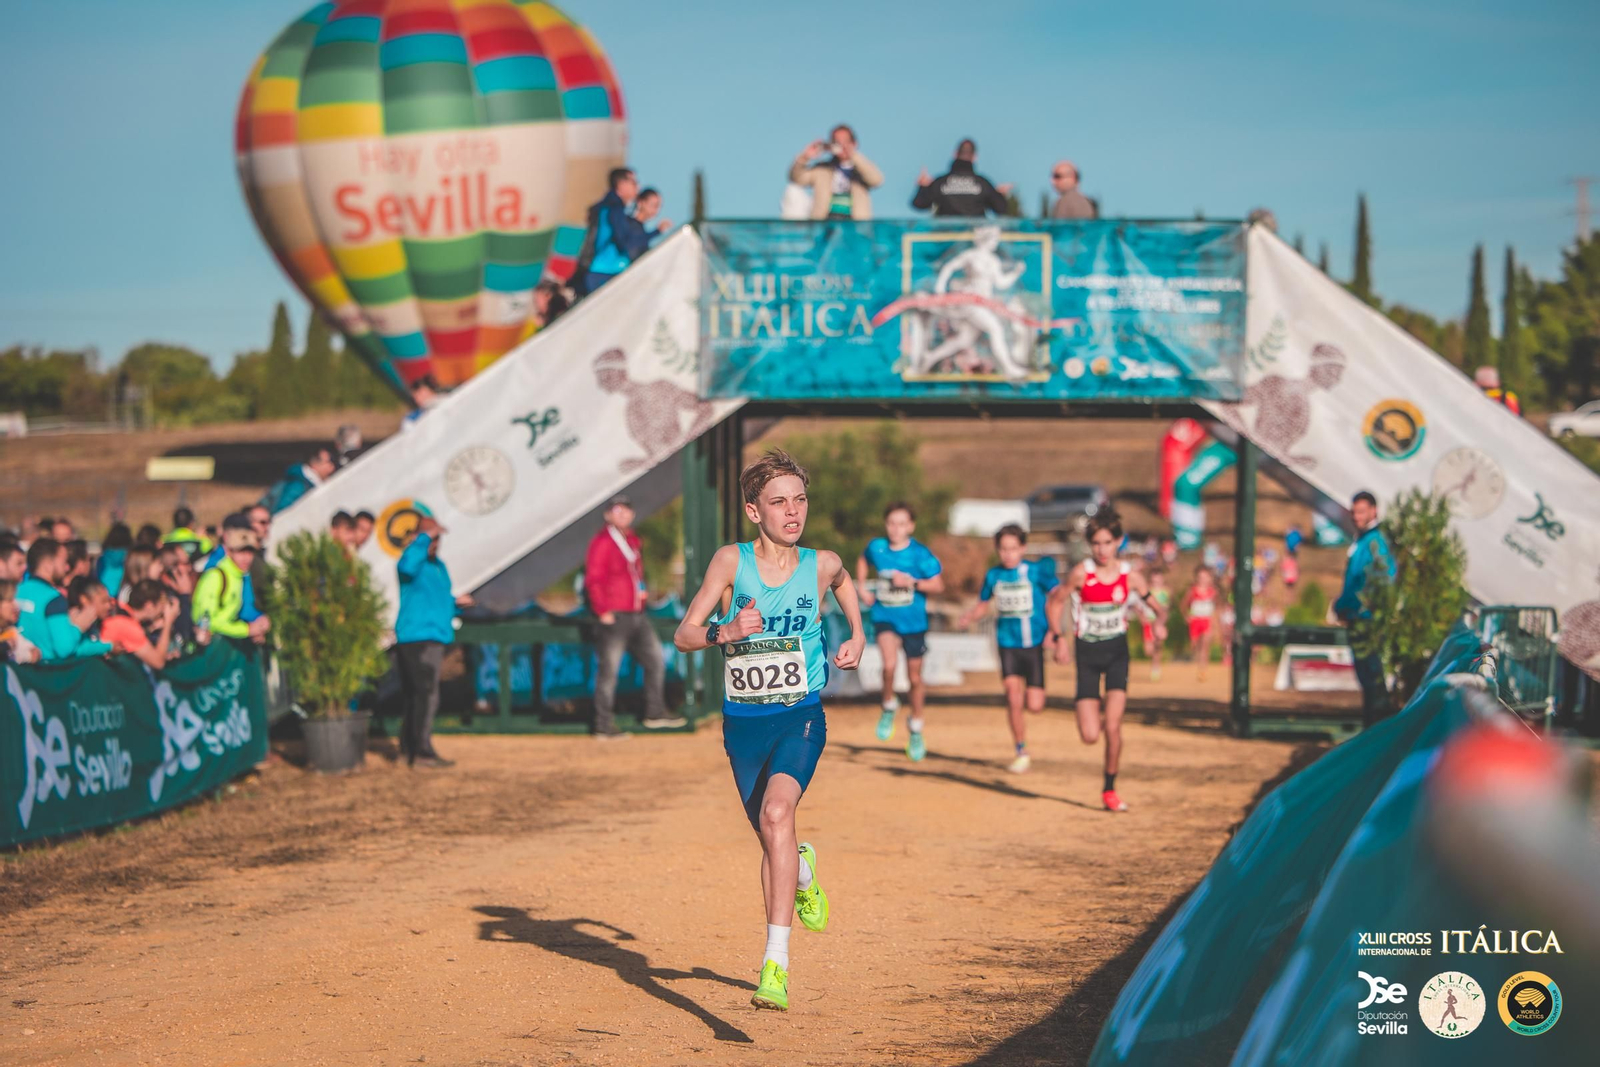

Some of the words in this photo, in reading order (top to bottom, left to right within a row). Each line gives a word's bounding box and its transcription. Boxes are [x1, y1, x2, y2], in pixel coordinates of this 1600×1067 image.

[358, 143, 422, 179] Hay
[436, 135, 499, 170] otra
[334, 171, 541, 244] Sevilla.
[730, 661, 802, 691] 8028
[74, 737, 133, 798] Sevilla
